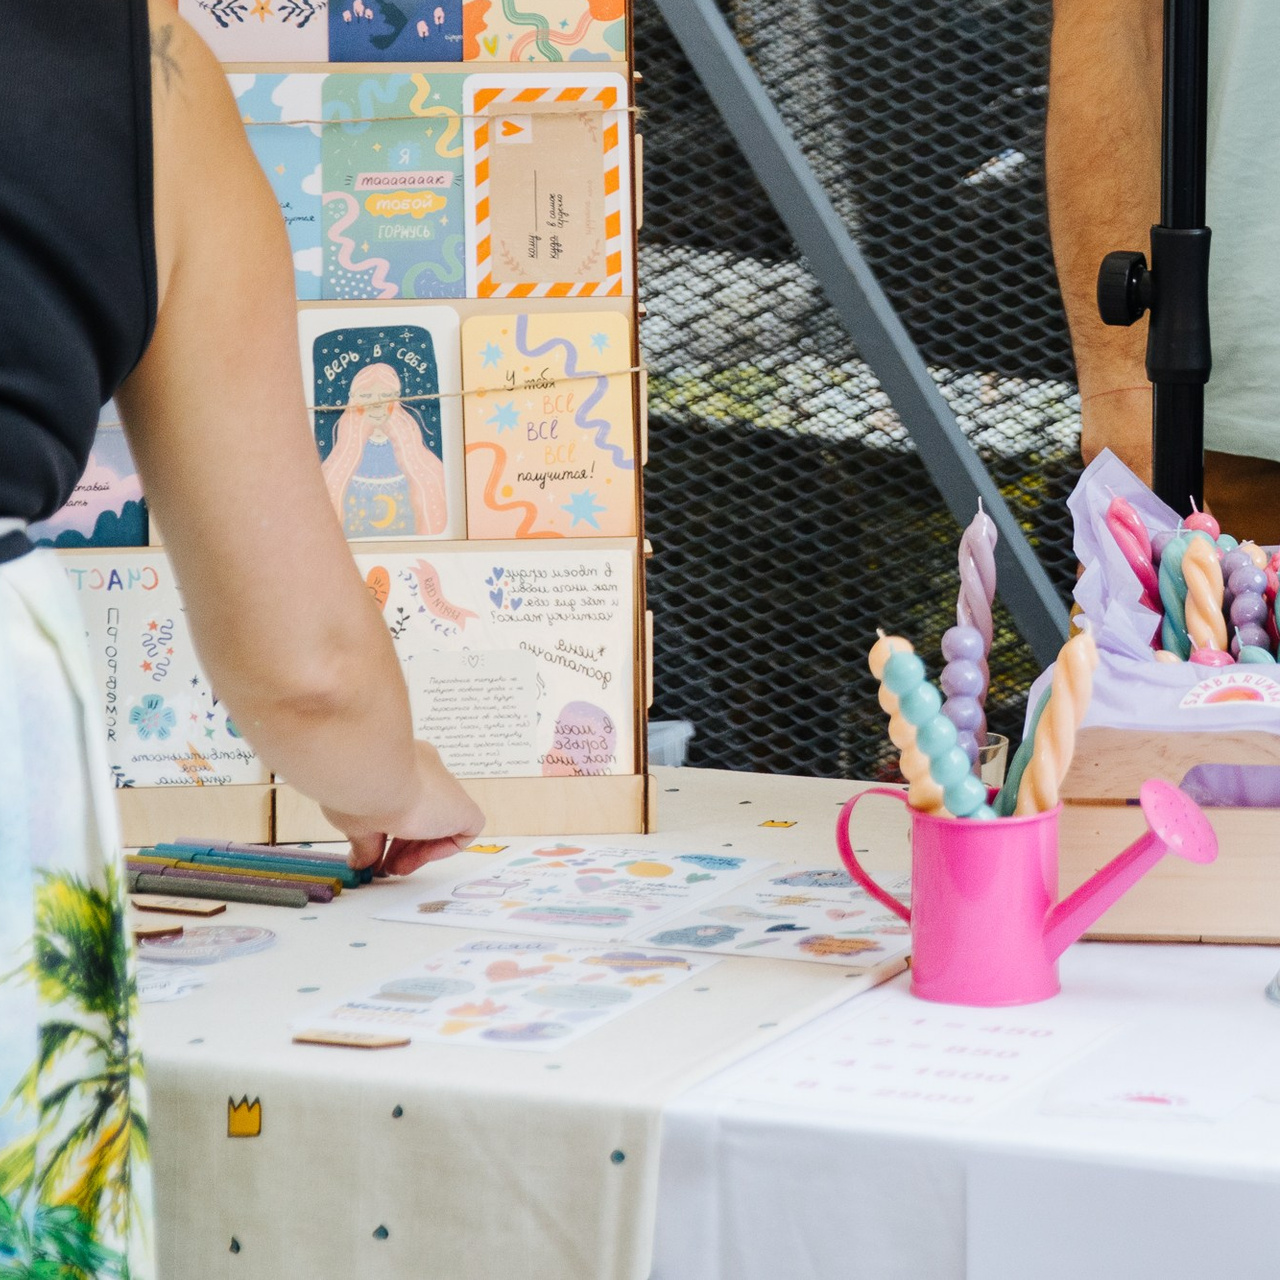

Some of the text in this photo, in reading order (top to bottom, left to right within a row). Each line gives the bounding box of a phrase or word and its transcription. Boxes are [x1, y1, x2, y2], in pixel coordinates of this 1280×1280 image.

[398, 148, 410, 165] Я
[377, 223, 432, 240] ГОРЖУСЬ
[517, 460, 596, 490] получится!
